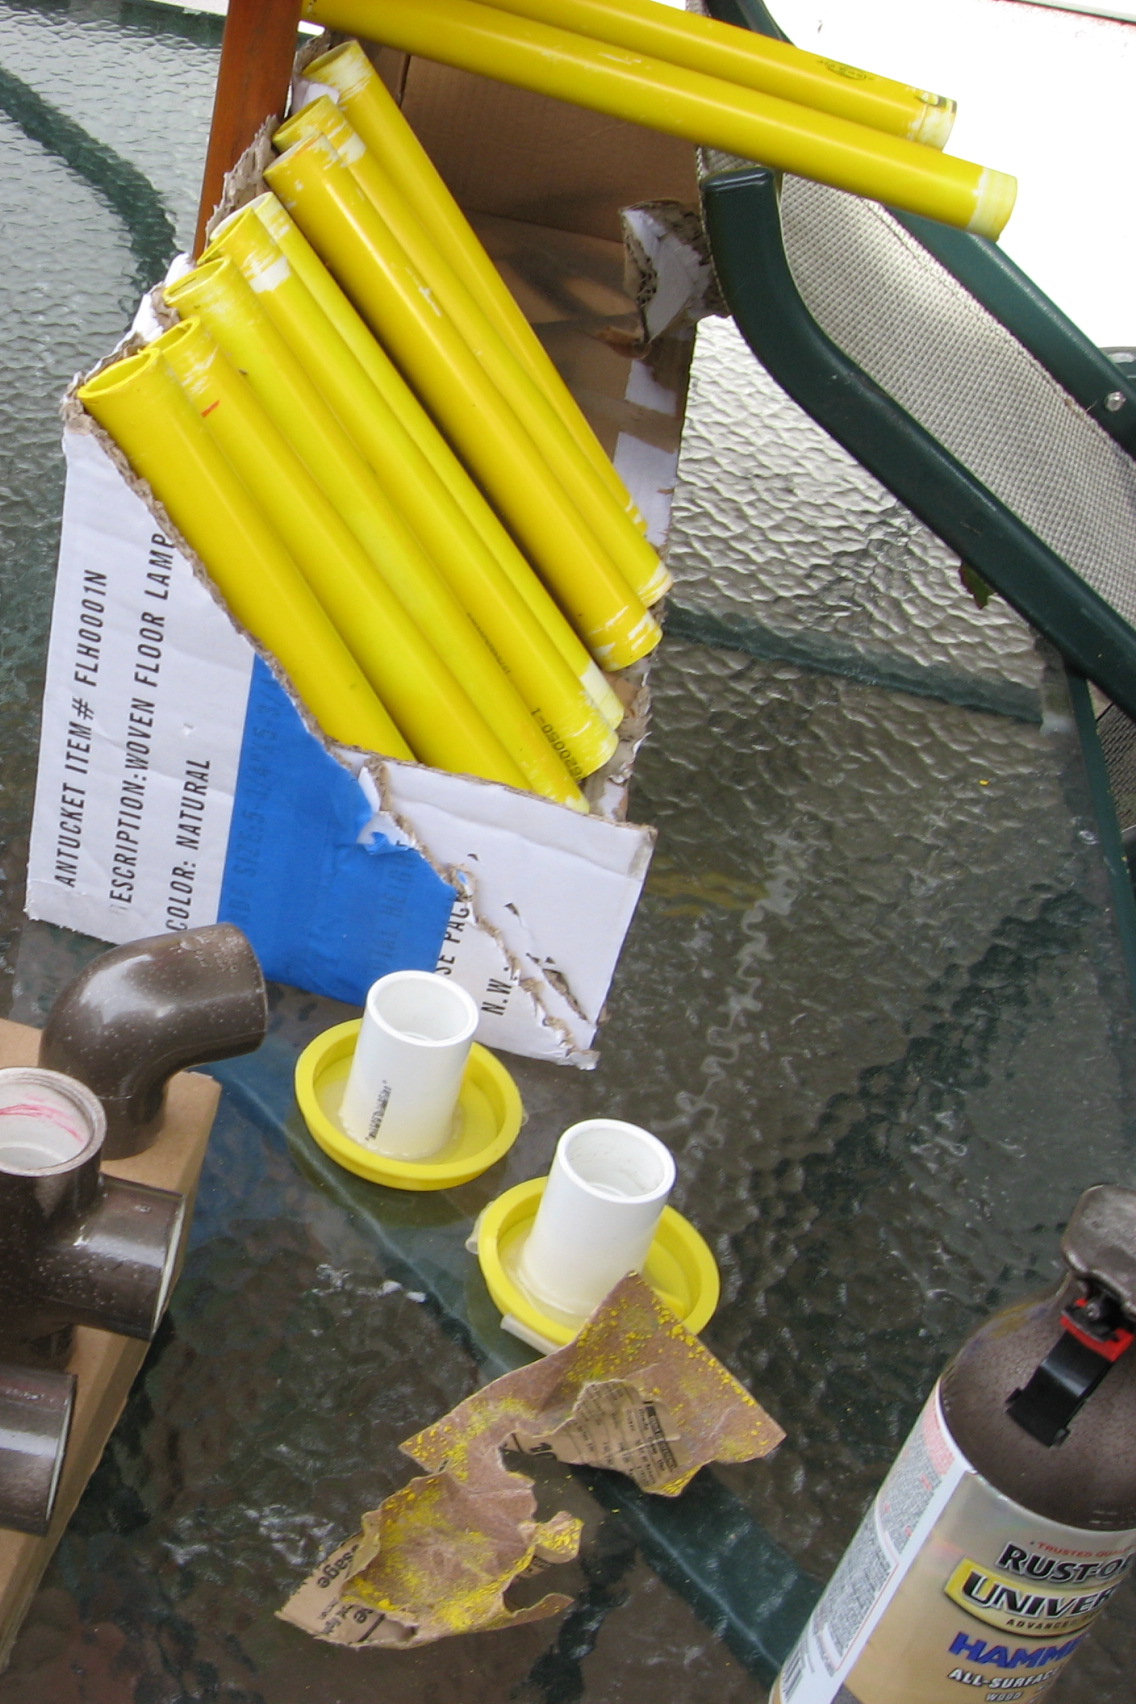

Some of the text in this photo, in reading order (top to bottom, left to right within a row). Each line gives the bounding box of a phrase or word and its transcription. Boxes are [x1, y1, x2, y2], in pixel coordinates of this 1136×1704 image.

[109, 533, 175, 912] ESCRIPTION:WOVEN FLOOR LAMP
[54, 782, 86, 888] ANTUCKET
[166, 759, 210, 931] COLOR: NATURAL
